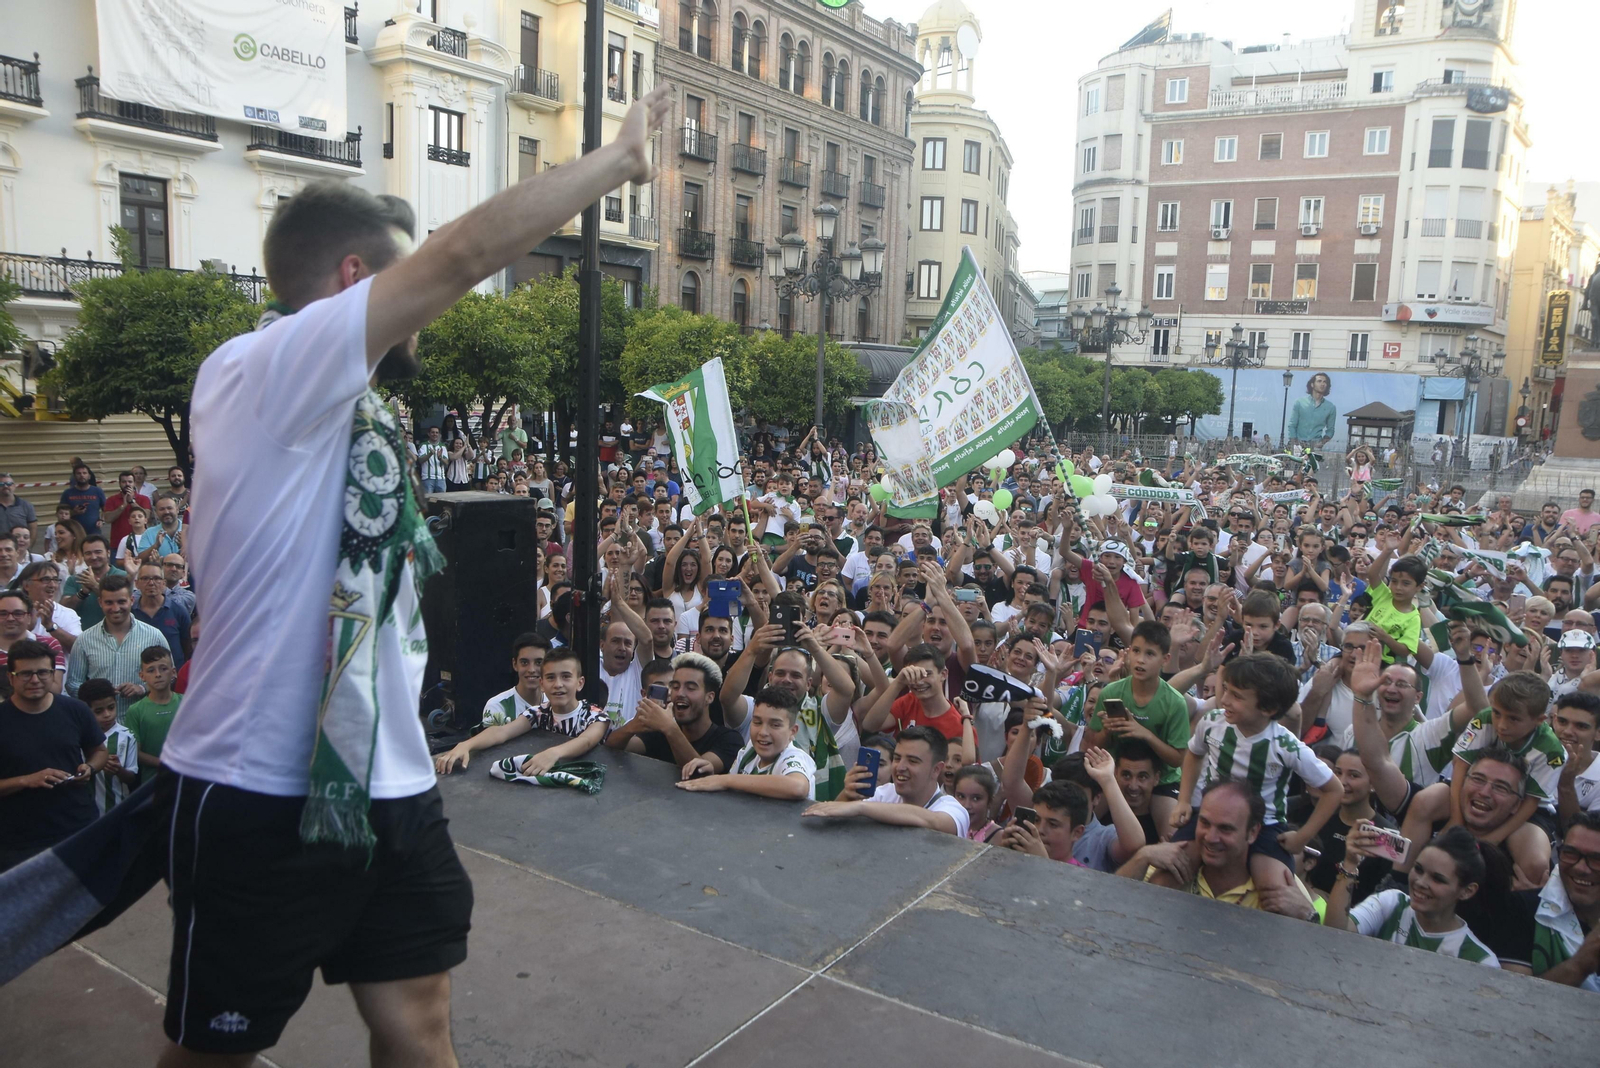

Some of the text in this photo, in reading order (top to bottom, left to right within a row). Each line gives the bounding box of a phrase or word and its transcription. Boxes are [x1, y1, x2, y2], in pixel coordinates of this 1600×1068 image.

[259, 43, 327, 70] CABELLO
[1150, 318, 1178, 327] OTEL
[1128, 488, 1180, 500] CÓRDOBA
